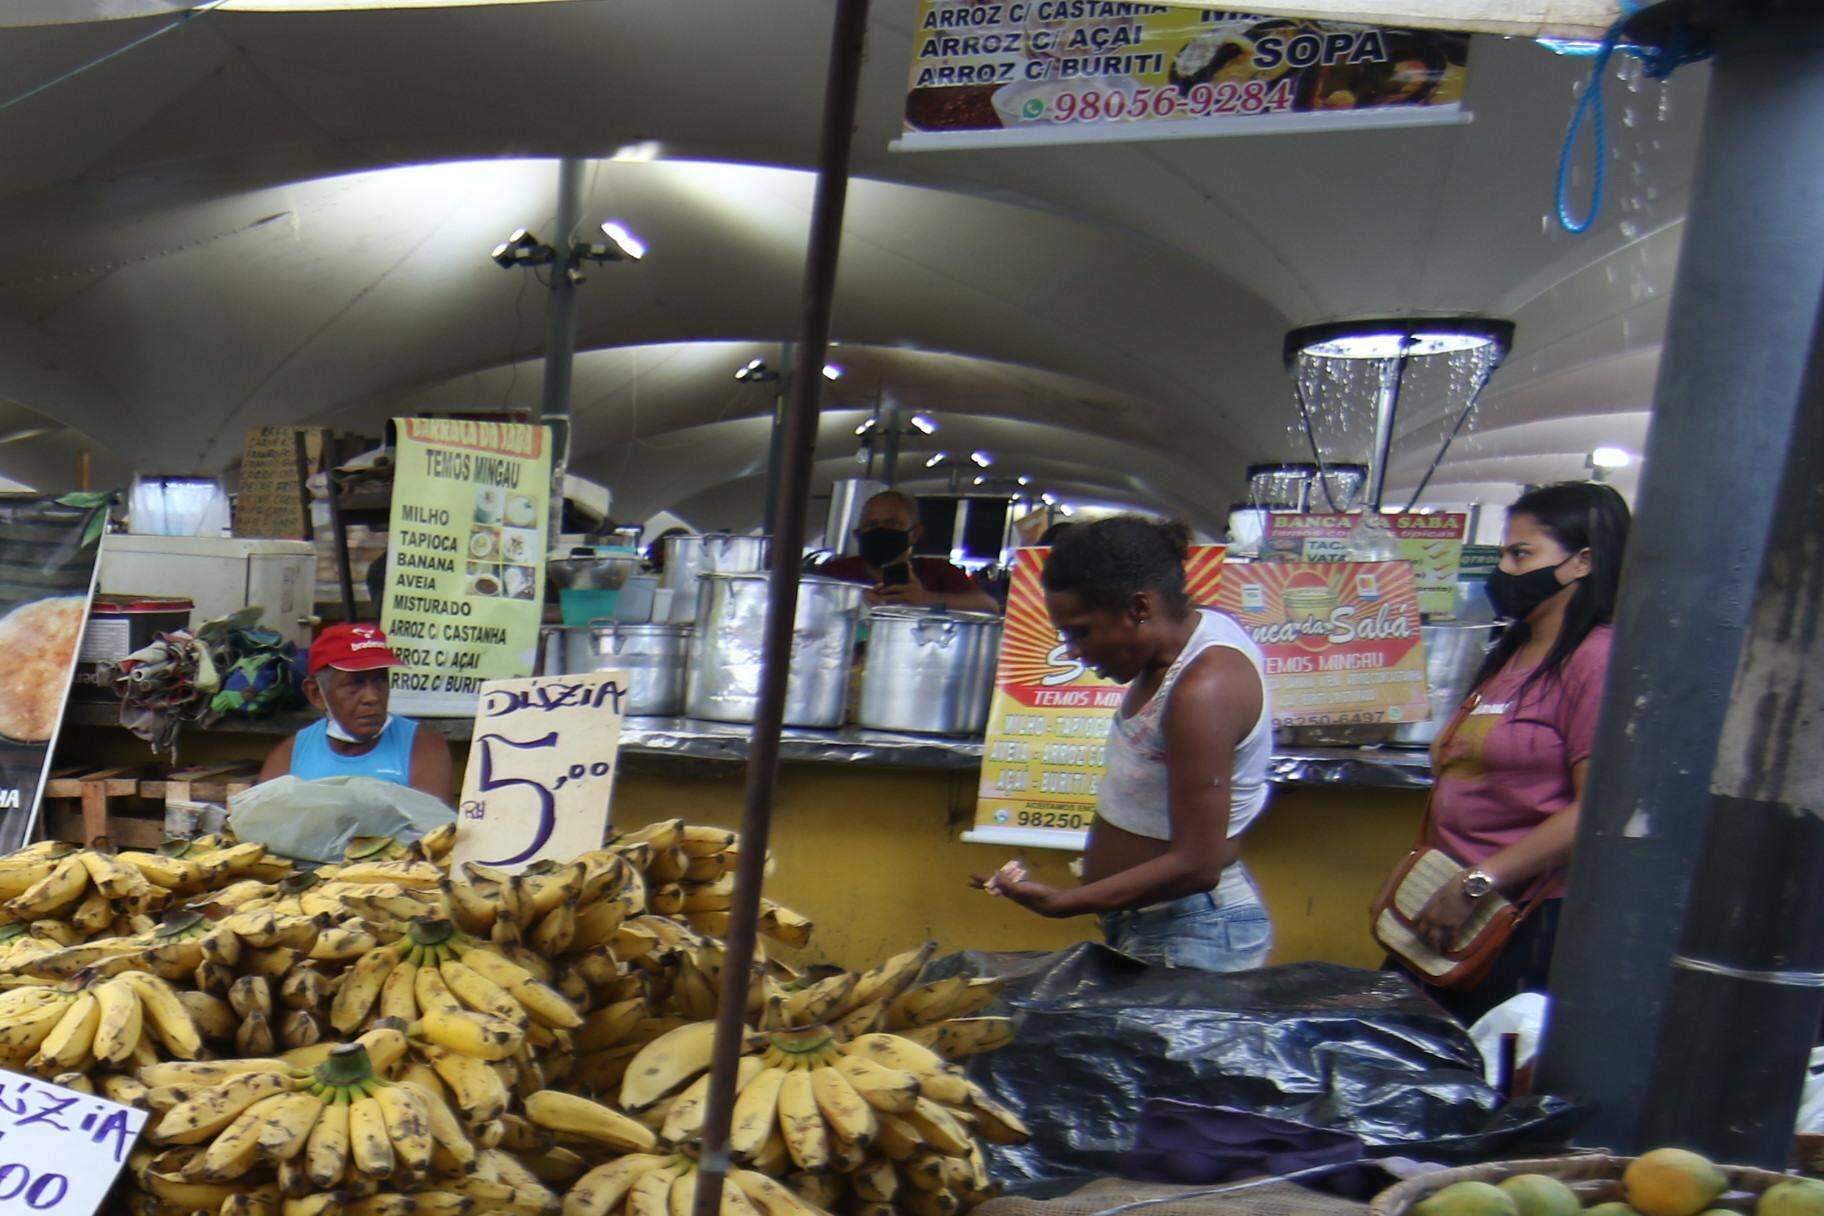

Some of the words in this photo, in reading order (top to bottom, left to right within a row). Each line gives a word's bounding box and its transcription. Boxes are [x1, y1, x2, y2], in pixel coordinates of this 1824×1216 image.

[923, 5, 1002, 29] ARROZ
[920, 33, 1022, 57] ARROZ
[1032, 31, 1060, 50] C/
[1068, 25, 1143, 53] AÇAI
[1253, 31, 1387, 68] SOPA
[916, 62, 1016, 86] ARROZ
[1024, 59, 1054, 80] C/
[1061, 53, 1163, 77] BURITI
[1054, 80, 1293, 122] 98056-9284
[426, 449, 471, 481] TEMOS
[472, 455, 520, 489] MINGAU
[402, 504, 449, 526] MILHO
[1274, 516, 1352, 529] BANCA
[1397, 513, 1459, 529] SABÁ
[400, 530, 458, 552] TAPIOCA
[1307, 540, 1346, 551] TAC
[397, 552, 455, 573] BANANA
[396, 574, 436, 591] AVEIA
[393, 595, 472, 617] MISTURADO
[389, 620, 425, 639] ARROZ
[443, 624, 507, 645] CASTANHA
[1329, 604, 1411, 643] Sabá
[392, 648, 431, 667] RROZ
[450, 652, 480, 672] AÇAI
[1265, 656, 1313, 674] EMOS
[1318, 652, 1384, 672] MINGAU
[391, 672, 430, 692] RROZ
[445, 675, 488, 695] BURIT
[1034, 690, 1090, 706] TEMOS
[1093, 691, 1124, 707] MIN
[476, 731, 610, 867] 5,00
[1017, 810, 1093, 829] 98250-
